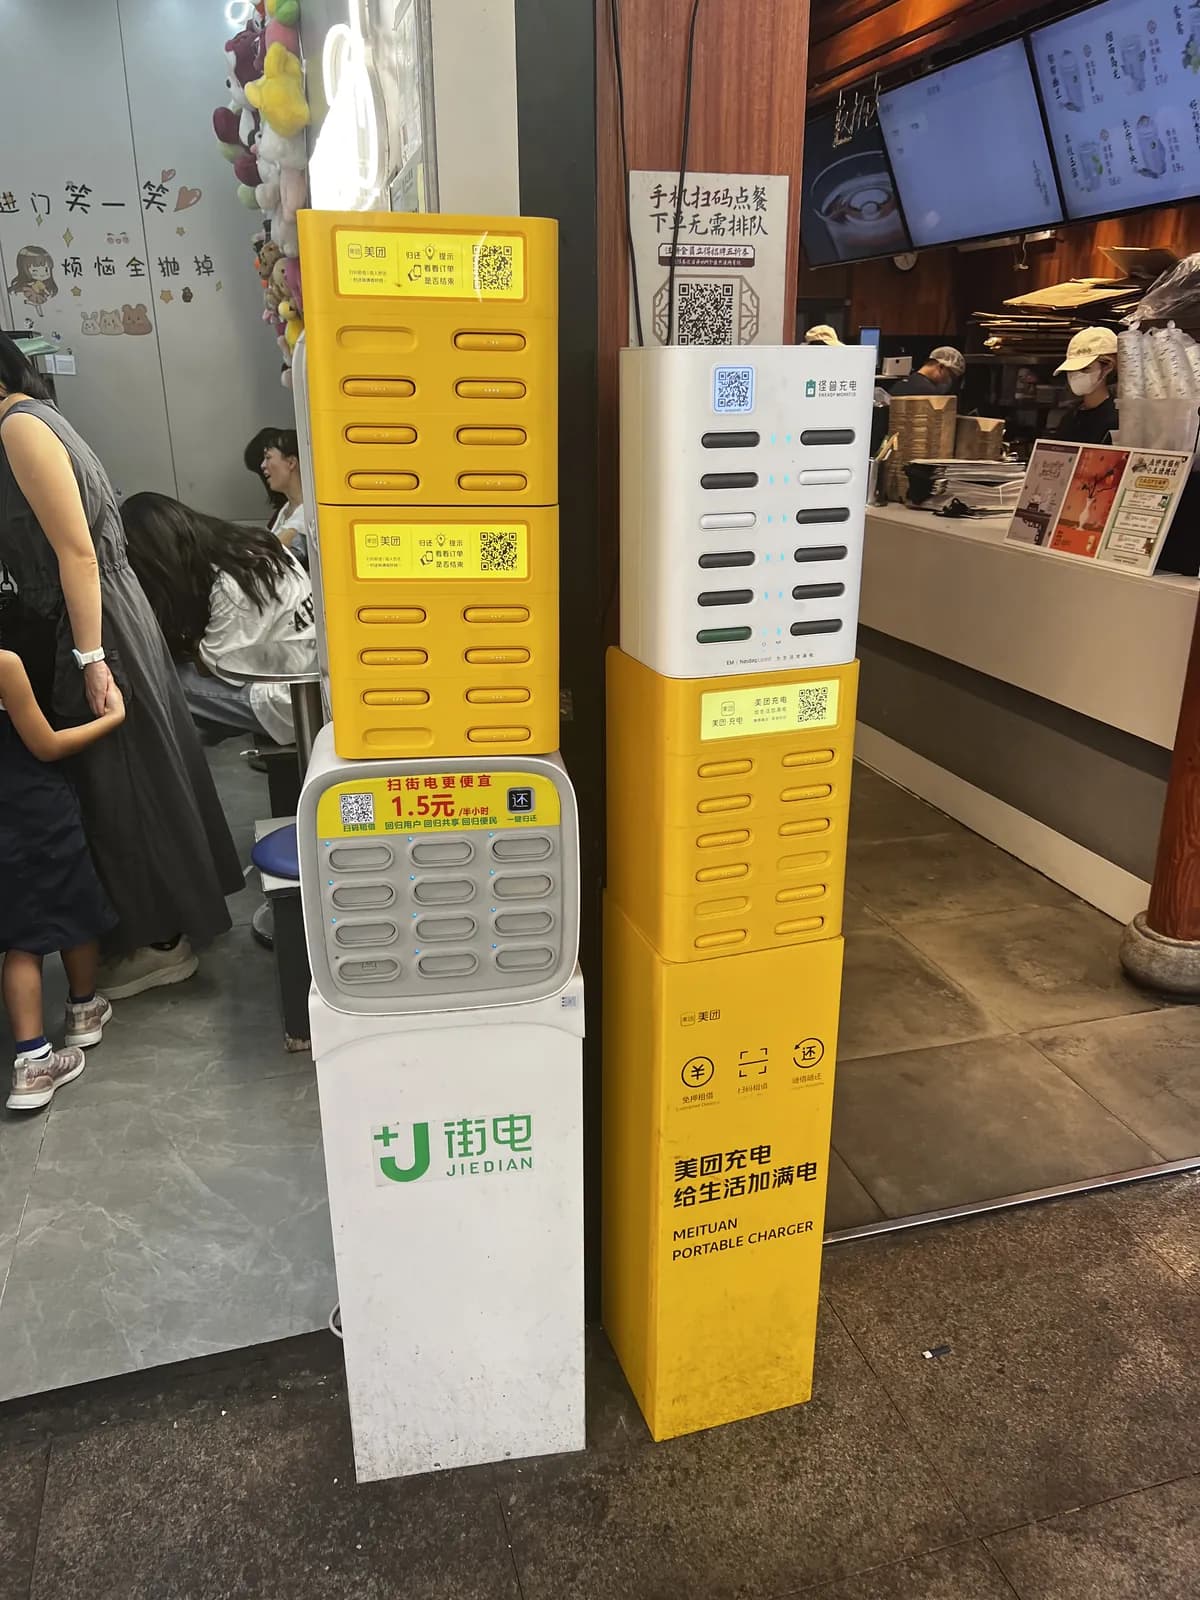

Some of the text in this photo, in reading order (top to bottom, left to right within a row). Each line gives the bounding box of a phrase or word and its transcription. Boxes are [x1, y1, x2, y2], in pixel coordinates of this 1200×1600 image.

[0, 181, 169, 214] 进门笑一笑
[649, 184, 768, 212] 手机扫码点餐
[648, 211, 769, 237] 下单无需排队
[364, 246, 386, 258] 美团
[61, 254, 215, 278] 烦恼全抛掉
[818, 380, 857, 392] 怪兽充电
[380, 536, 400, 547] 美团
[386, 774, 493, 791] 扫街电更便宜
[512, 792, 529, 808] 还
[384, 816, 498, 831] 回归用户 回归共享 回归便民
[698, 1009, 721, 1023] 美团
[444, 1114, 532, 1159] 街电
[446, 1157, 533, 1177] JIEDIAN
[674, 1144, 772, 1182] 美团充电
[673, 1161, 818, 1208] 给生活加满电
[672, 1220, 814, 1262] PORTABLE CHARGER
[673, 1217, 738, 1242] MEITUAN
